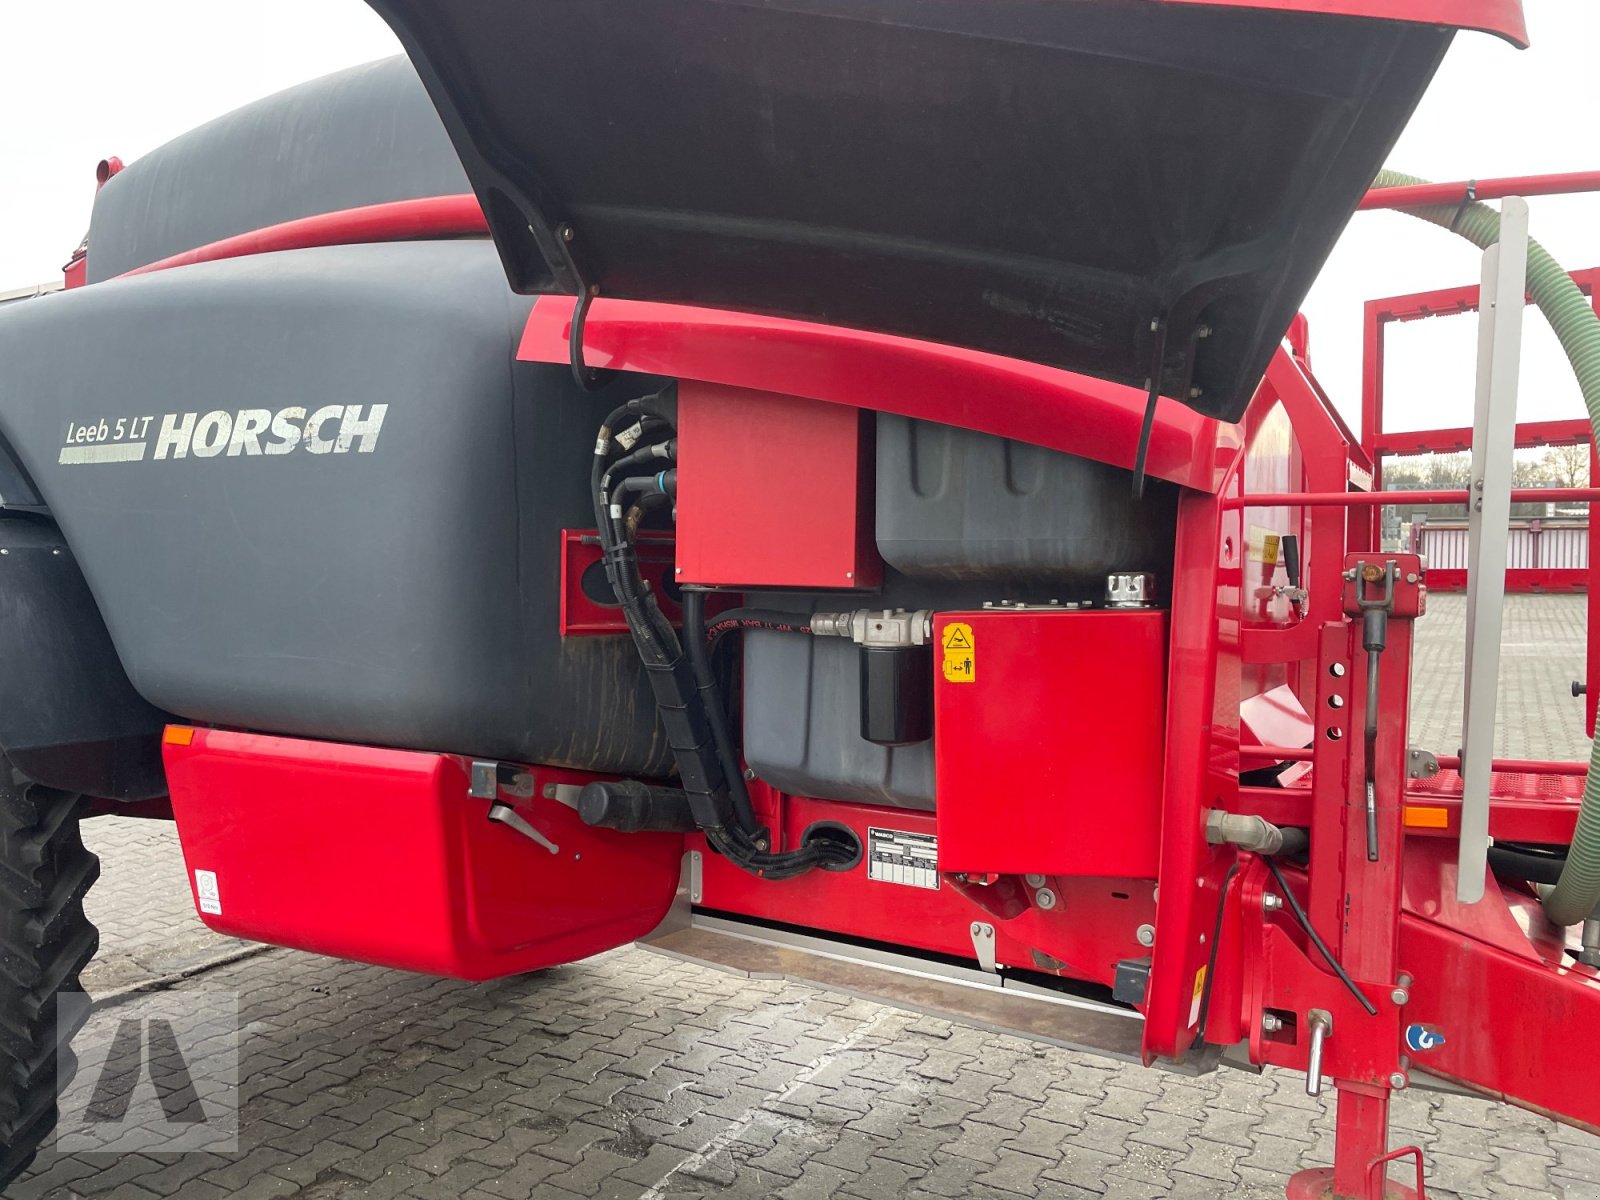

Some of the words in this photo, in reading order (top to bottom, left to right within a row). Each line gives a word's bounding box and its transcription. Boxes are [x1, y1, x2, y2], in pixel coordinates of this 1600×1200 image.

[66, 418, 109, 444] Leeb
[113, 418, 127, 440] 5
[129, 416, 154, 439] LT
[153, 404, 388, 460] HORSCH
